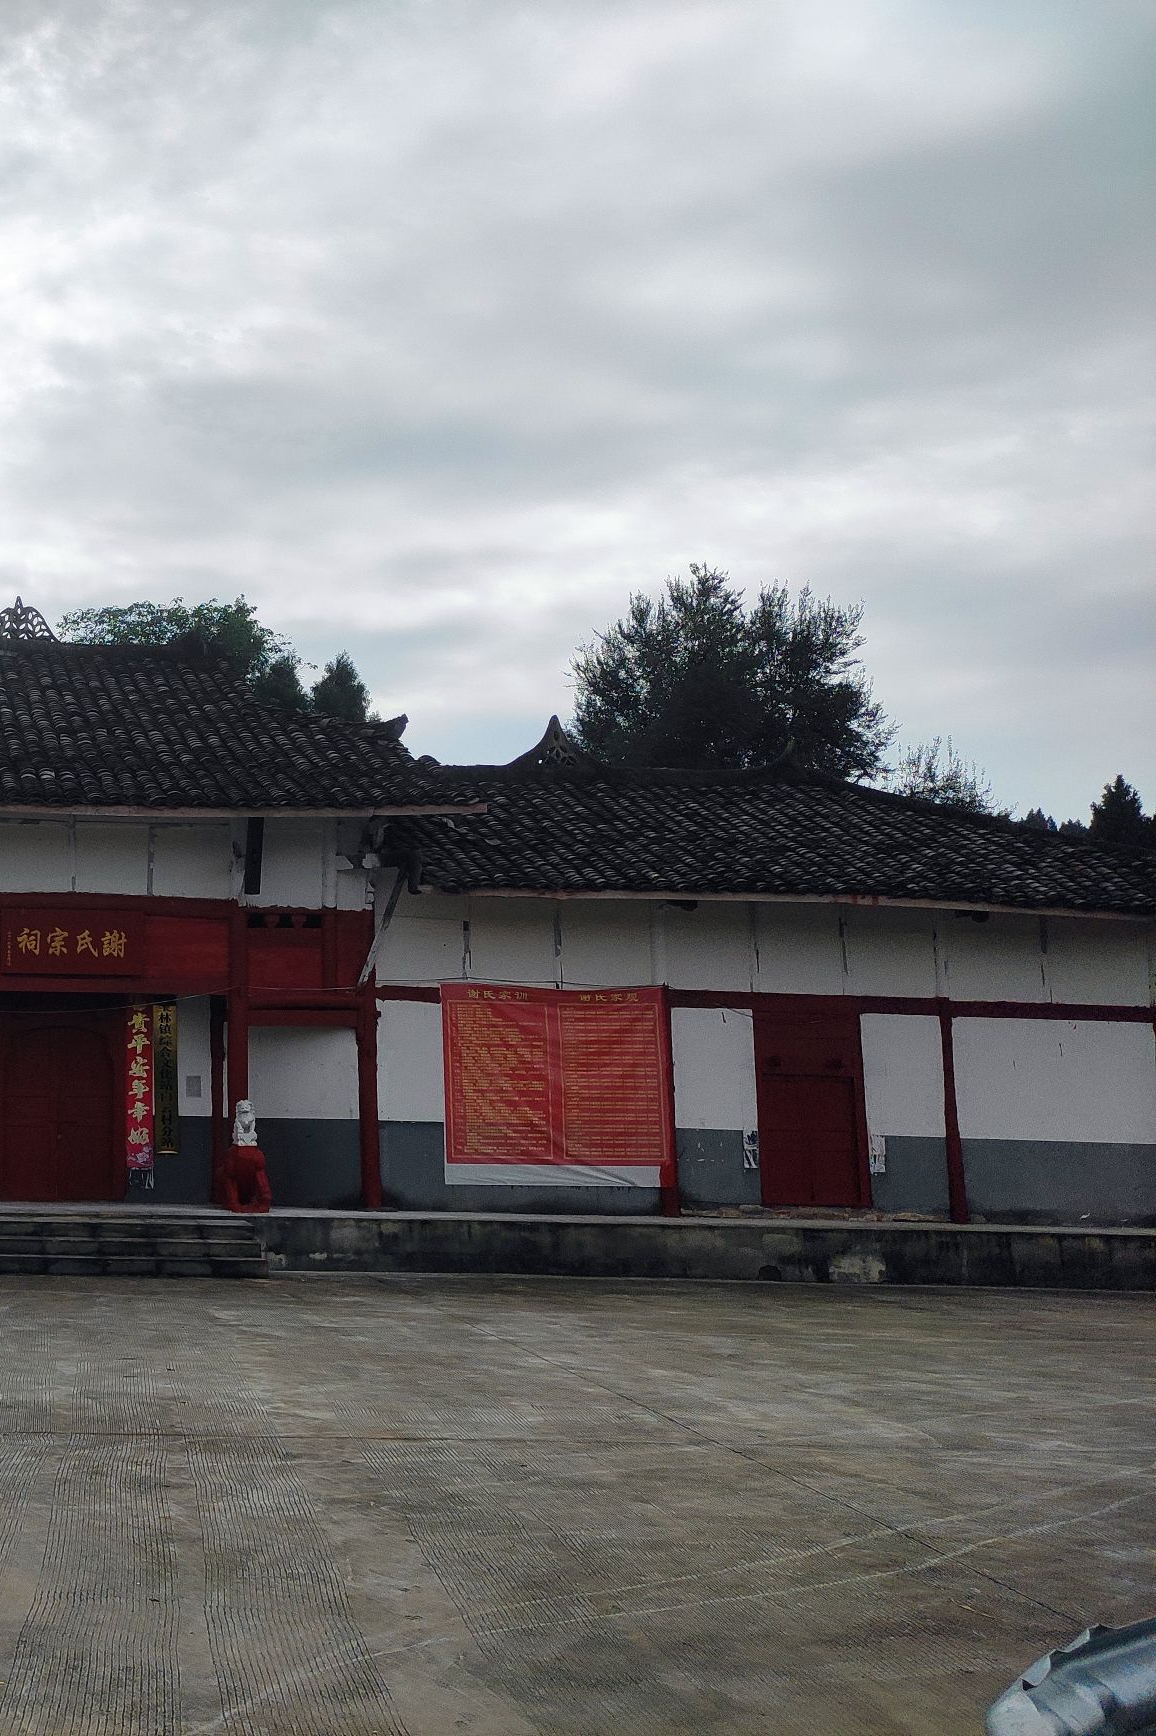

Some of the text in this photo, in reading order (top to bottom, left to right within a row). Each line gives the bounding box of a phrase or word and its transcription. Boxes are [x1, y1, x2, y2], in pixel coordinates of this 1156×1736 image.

[16, 927, 128, 959] 謝氏宗祠
[467, 989, 528, 1001] 谢氏家训
[579, 991, 640, 1002] 谢氏家规
